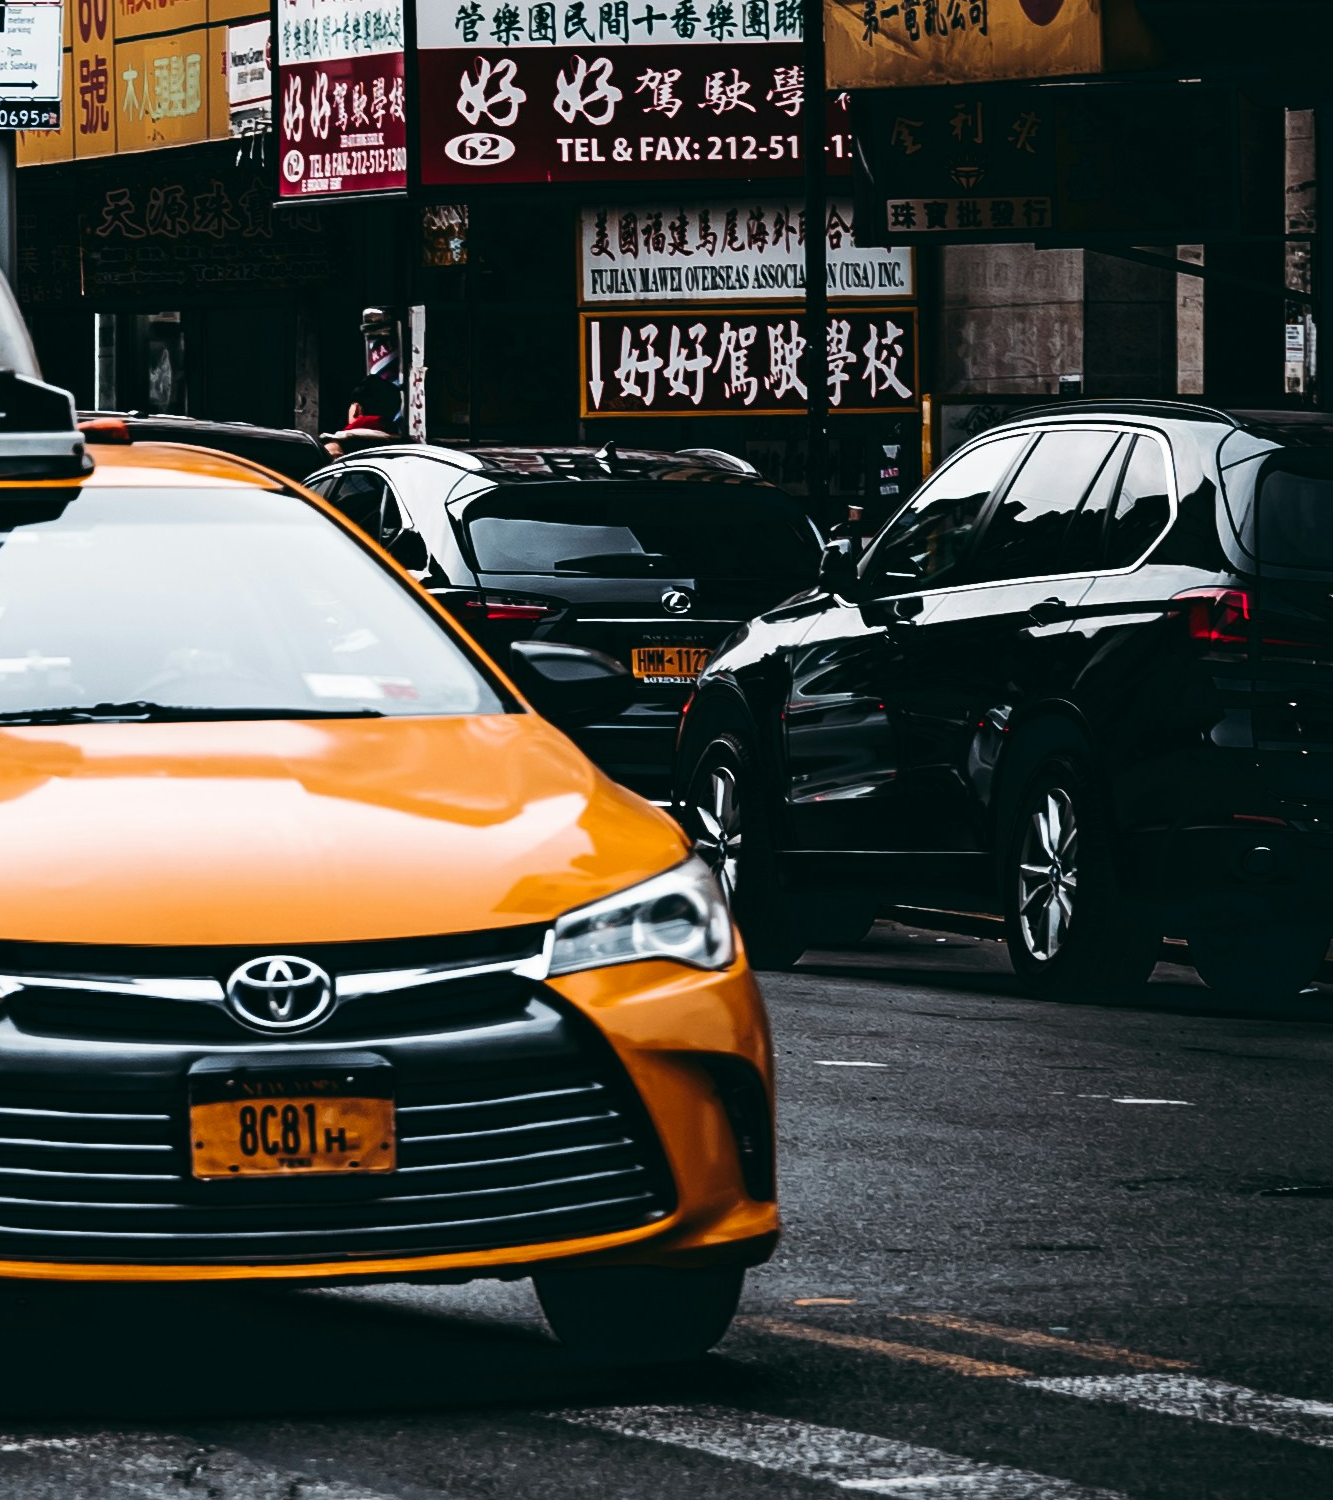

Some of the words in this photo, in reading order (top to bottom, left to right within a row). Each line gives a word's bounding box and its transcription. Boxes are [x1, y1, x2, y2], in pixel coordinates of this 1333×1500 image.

[10, 60, 38, 72] Sunday
[456, 53, 851, 128] 好好駕駛學
[556, 137, 606, 163] TEL
[611, 137, 633, 162] &
[639, 136, 701, 163] FAX:
[309, 154, 323, 178] TEL
[590, 267, 637, 295] FUJIAN
[639, 266, 683, 293] MAWEI
[684, 264, 750, 292] OVERSEAS
[751, 262, 837, 290] ASSOCIAN
[839, 260, 876, 291] (USA)
[877, 261, 905, 288] INC.
[614, 319, 914, 407] 好好駕駛學校
